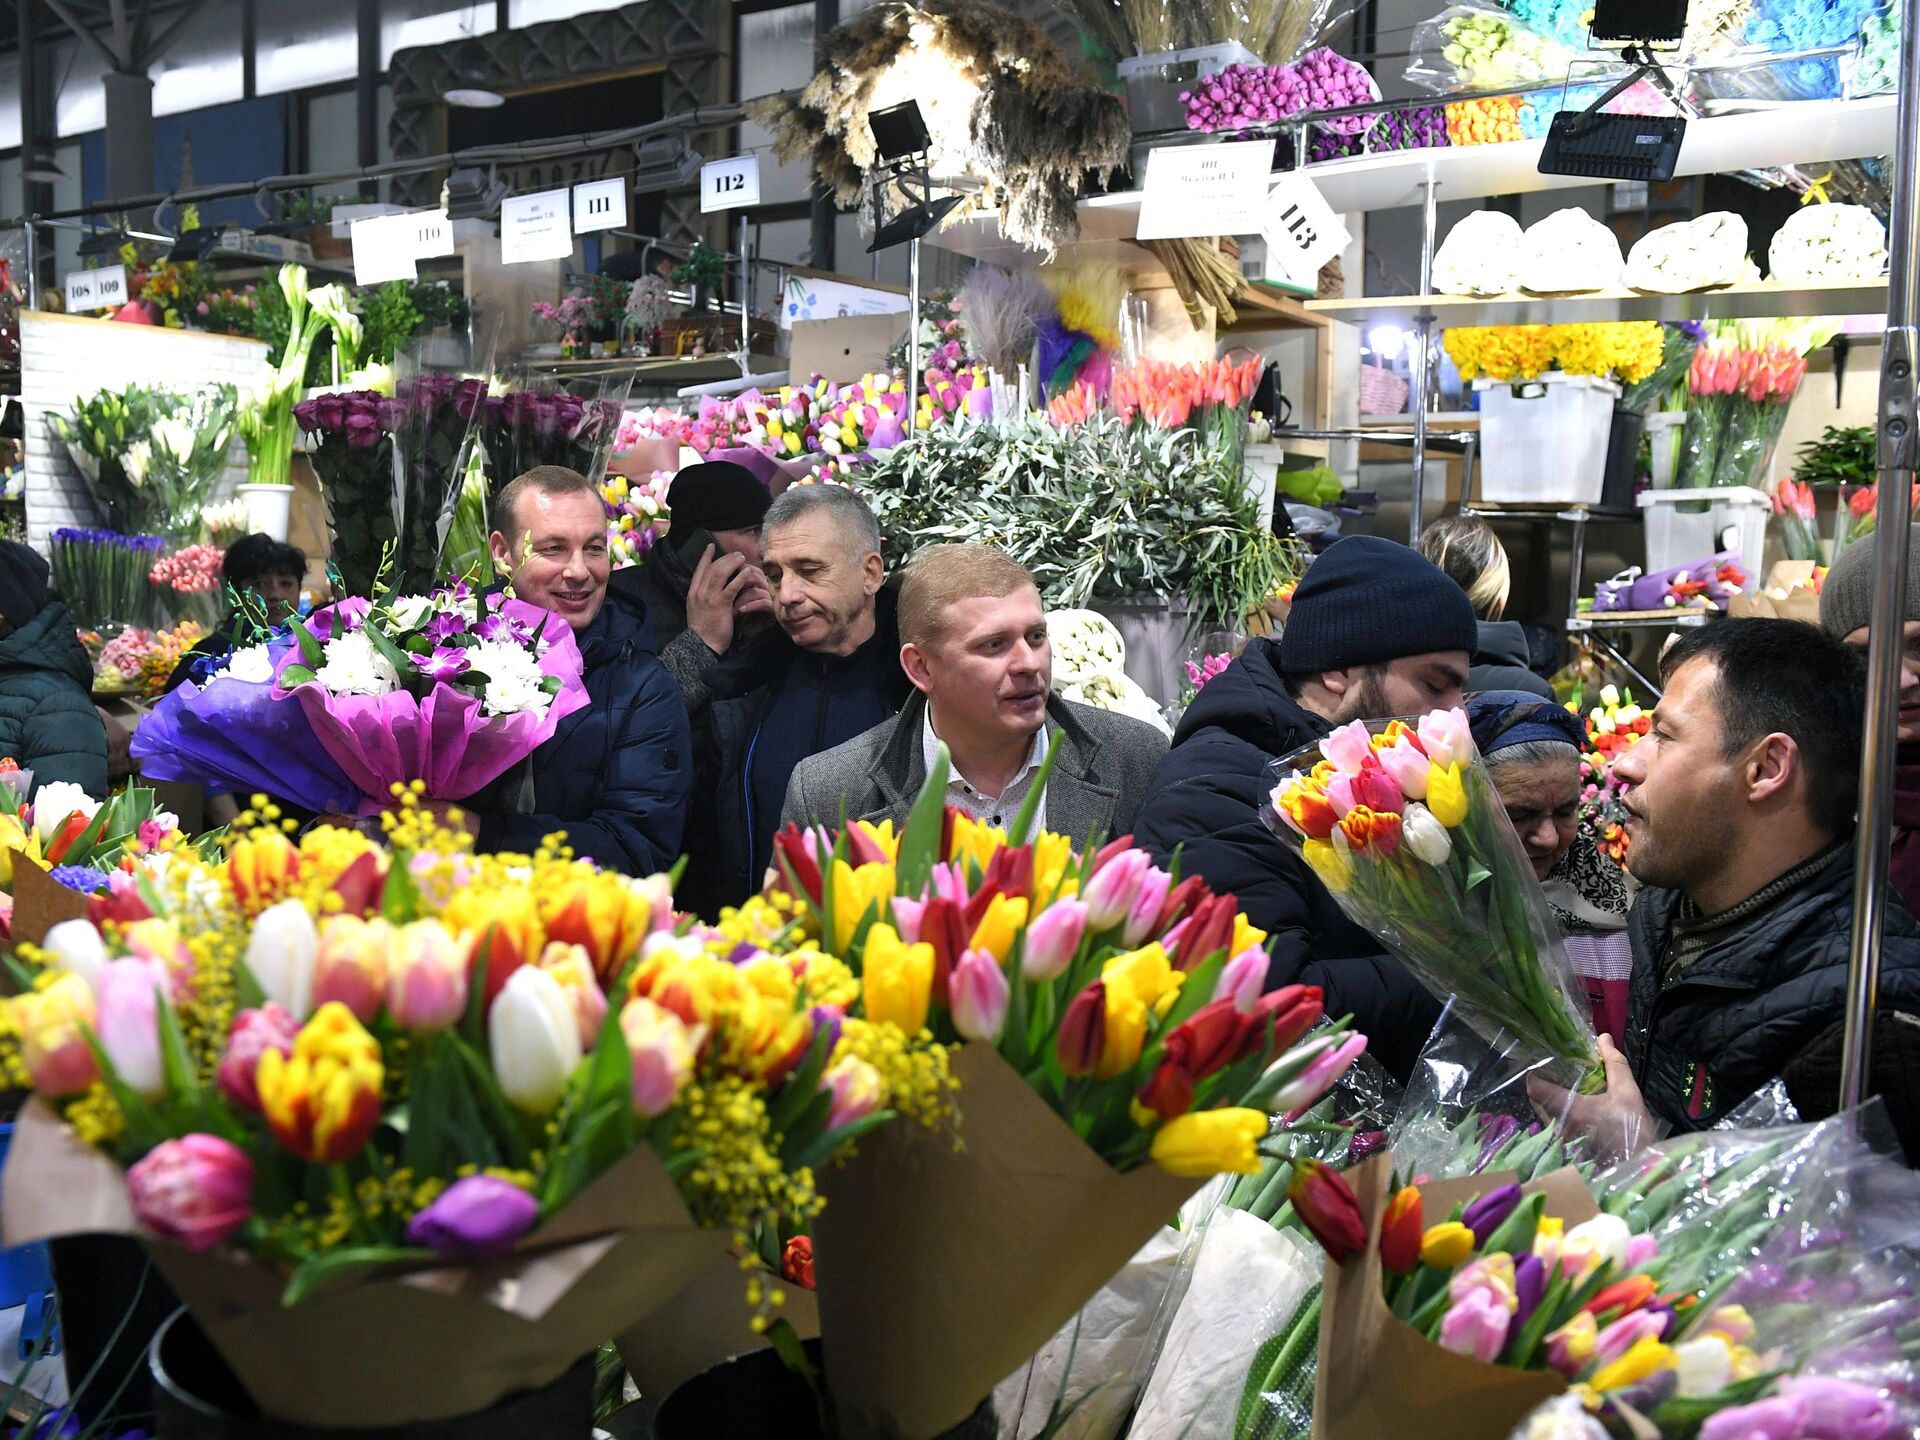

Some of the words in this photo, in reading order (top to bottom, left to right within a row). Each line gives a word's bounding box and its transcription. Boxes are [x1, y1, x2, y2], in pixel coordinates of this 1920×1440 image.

[716, 173, 744, 193] 112
[588, 196, 610, 215] 111
[418, 226, 441, 242] 110
[1280, 203, 1317, 249] 113
[71, 283, 90, 298] 108
[100, 280, 119, 294] 109
